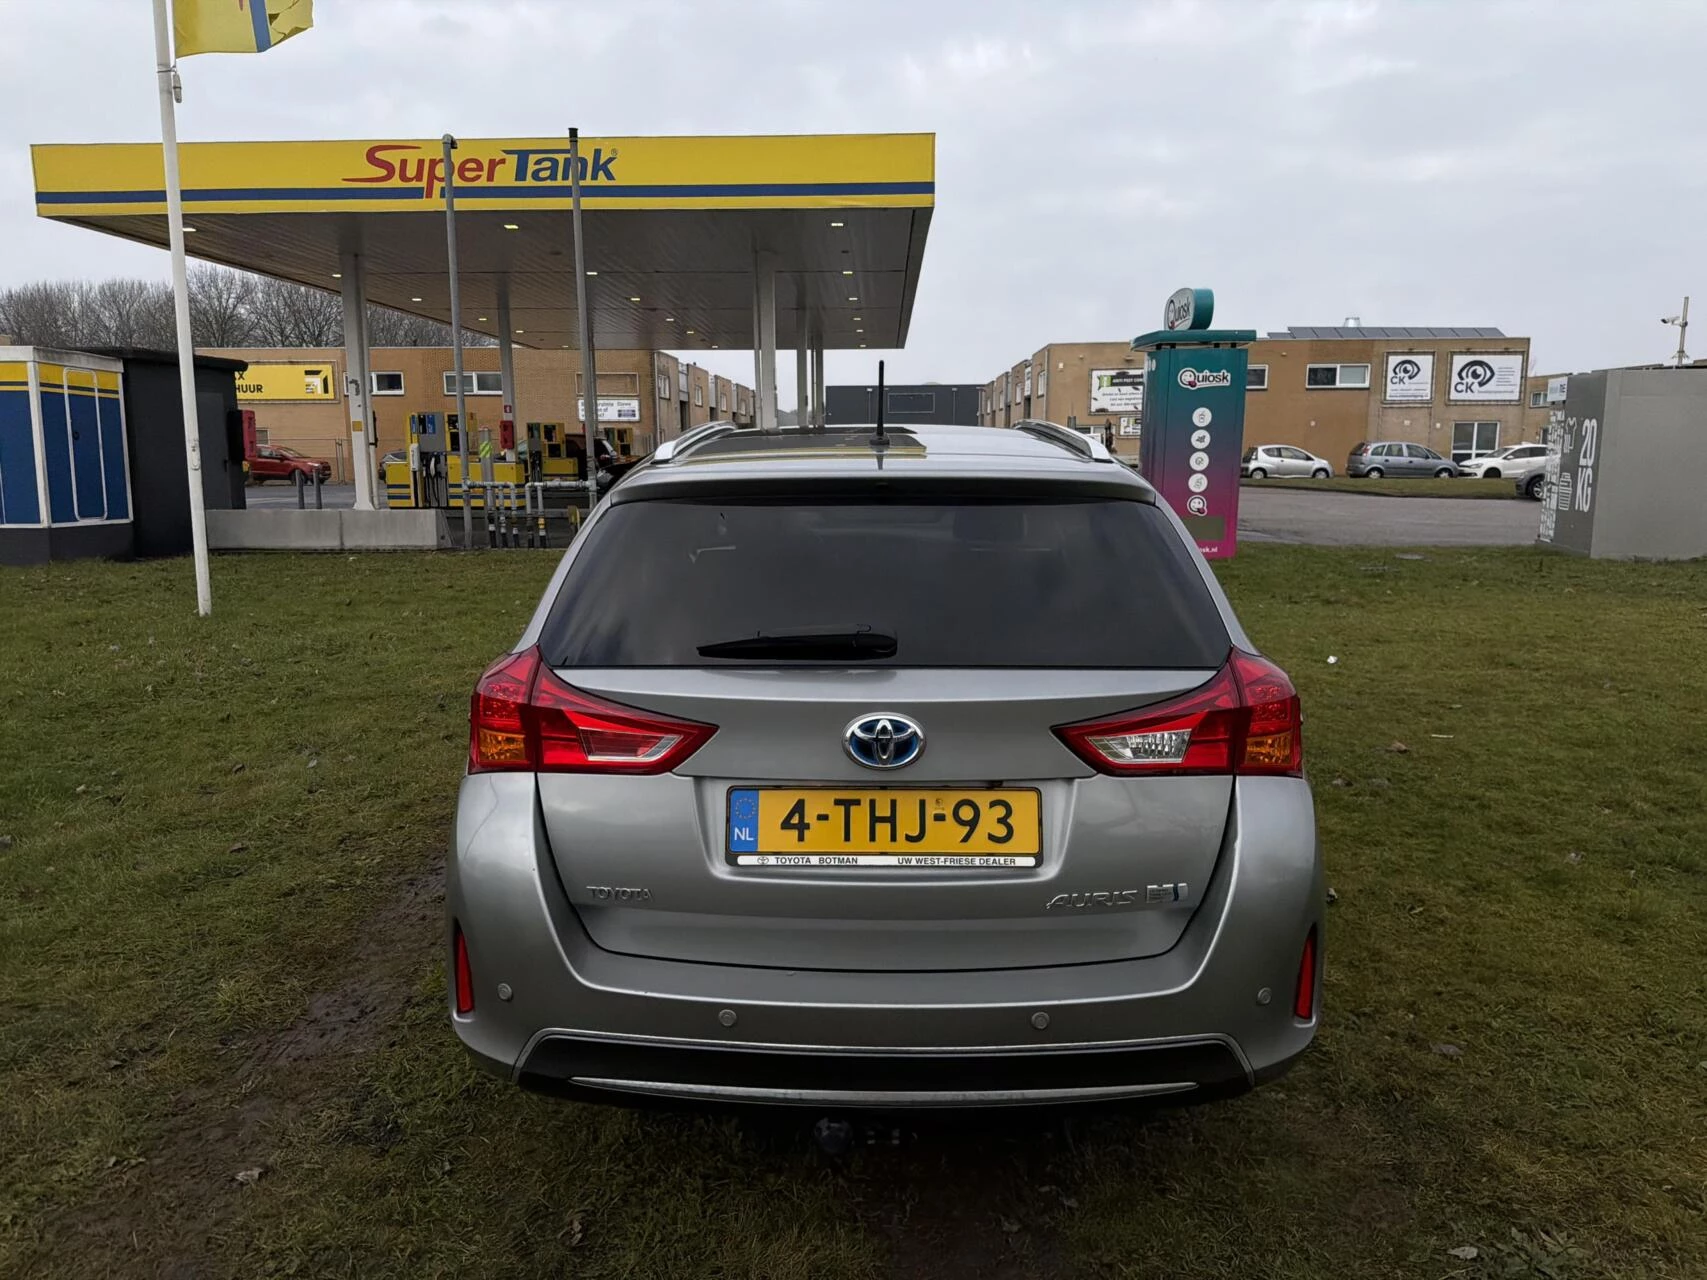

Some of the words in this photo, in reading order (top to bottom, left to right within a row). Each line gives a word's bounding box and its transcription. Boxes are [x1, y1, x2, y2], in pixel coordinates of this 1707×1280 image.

[341, 144, 617, 199] SuperTank
[1179, 369, 1229, 388] Quiosk
[1390, 375, 1406, 385] CK
[1454, 381, 1475, 394] CK
[1580, 418, 1597, 467] 20
[1575, 467, 1593, 513] KG
[780, 798, 1015, 844] 4-THJ-93
[733, 829, 754, 841] NL
[775, 857, 811, 865] TOYOTA
[819, 857, 858, 865] BOTMAN
[898, 857, 913, 865] UW
[914, 857, 977, 865] WEST-FRIESE
[978, 857, 1016, 866] DEALER
[586, 885, 654, 901] TOYOTA
[1046, 889, 1138, 910] AURIS
